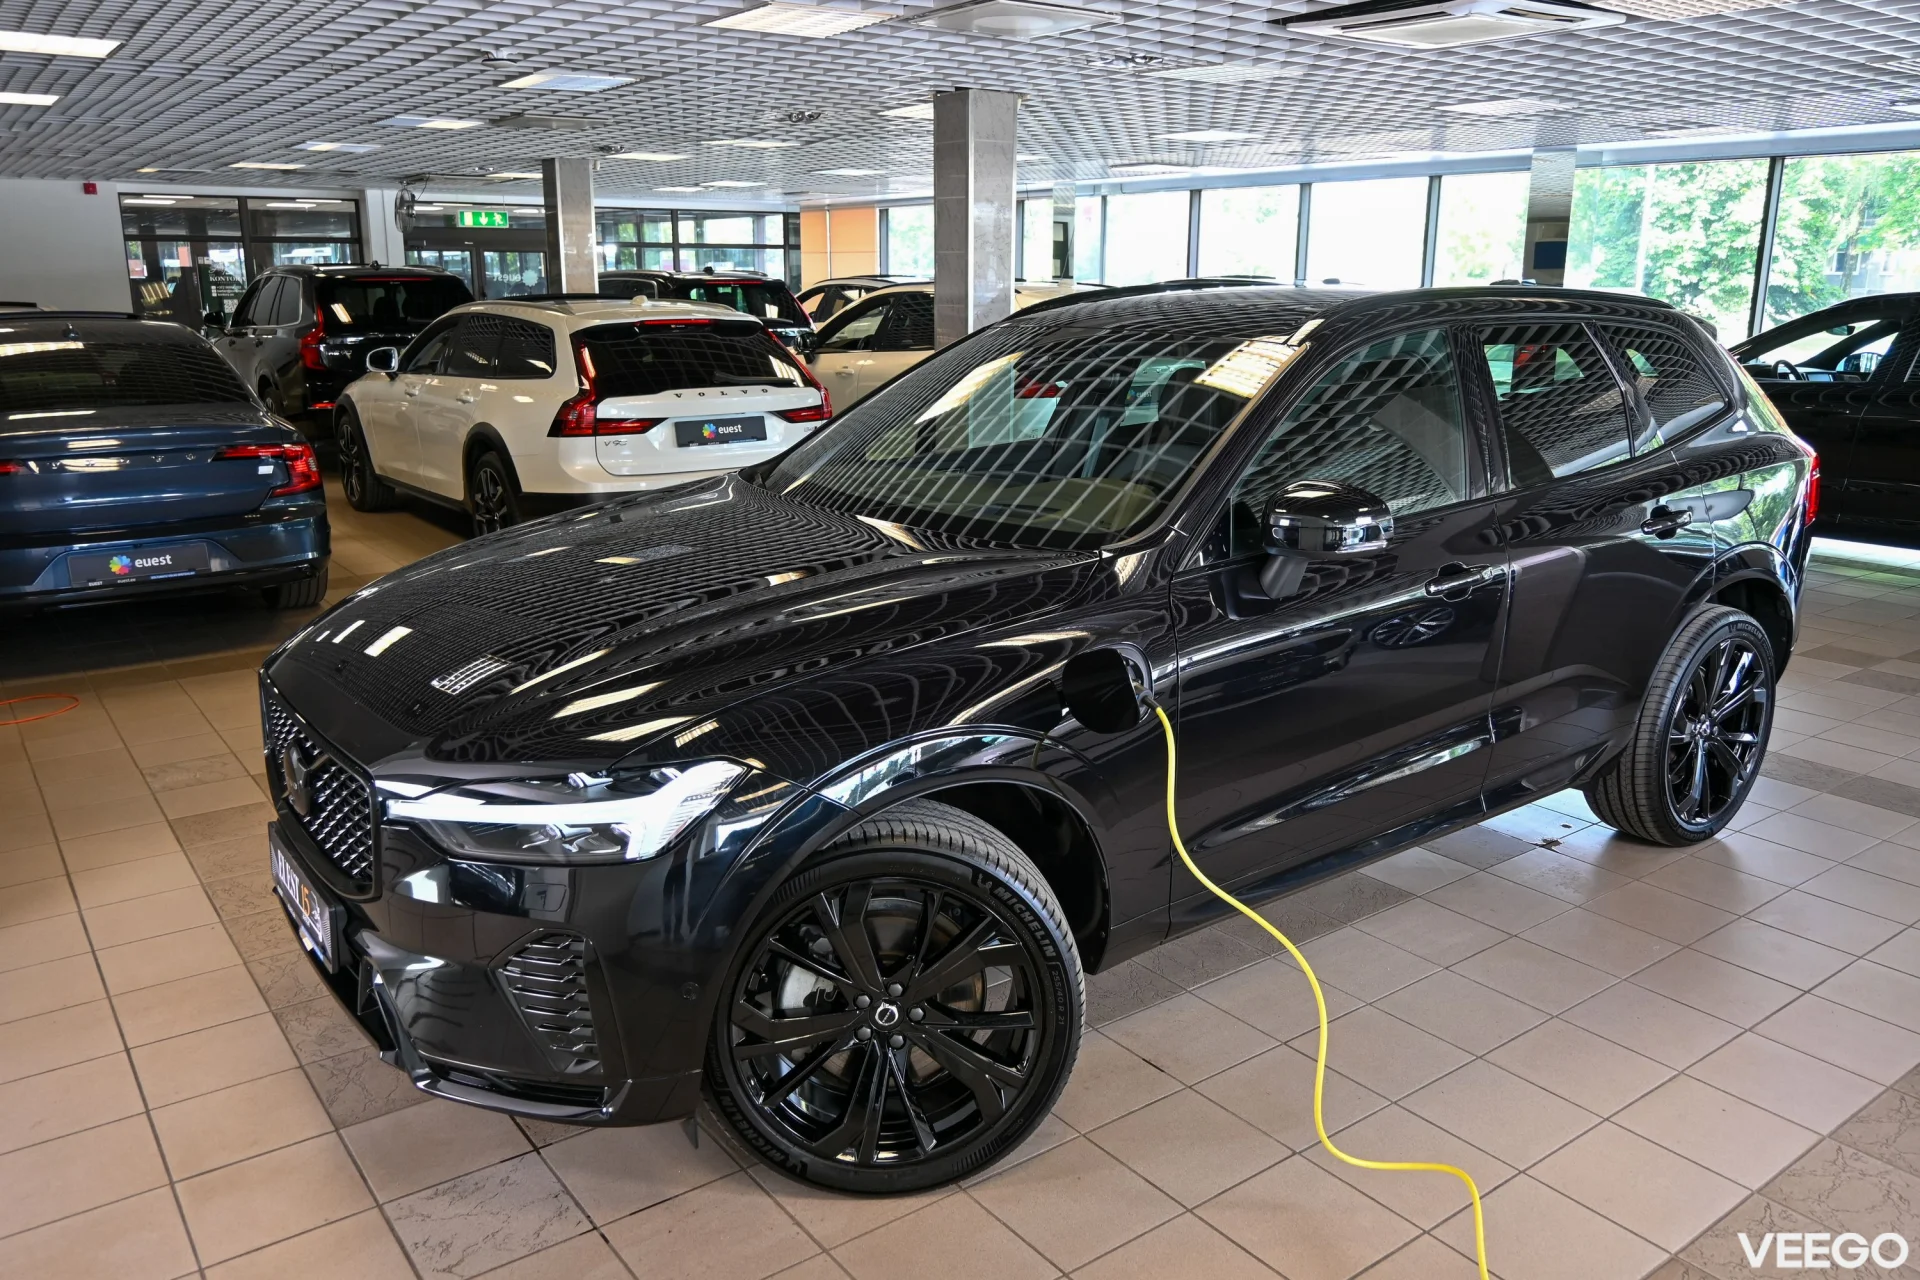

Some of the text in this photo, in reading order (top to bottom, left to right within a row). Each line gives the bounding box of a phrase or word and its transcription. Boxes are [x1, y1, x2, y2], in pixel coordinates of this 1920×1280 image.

[673, 388, 769, 399] VOLVO
[718, 424, 743, 434] euest
[134, 554, 172, 568] euest
[1737, 622, 1763, 639] MICHELIN
[300, 884, 311, 917] 15
[993, 886, 1057, 957] MICHELIN
[1051, 970, 1065, 1004] 255/40
[719, 1094, 787, 1163] MICHELIN
